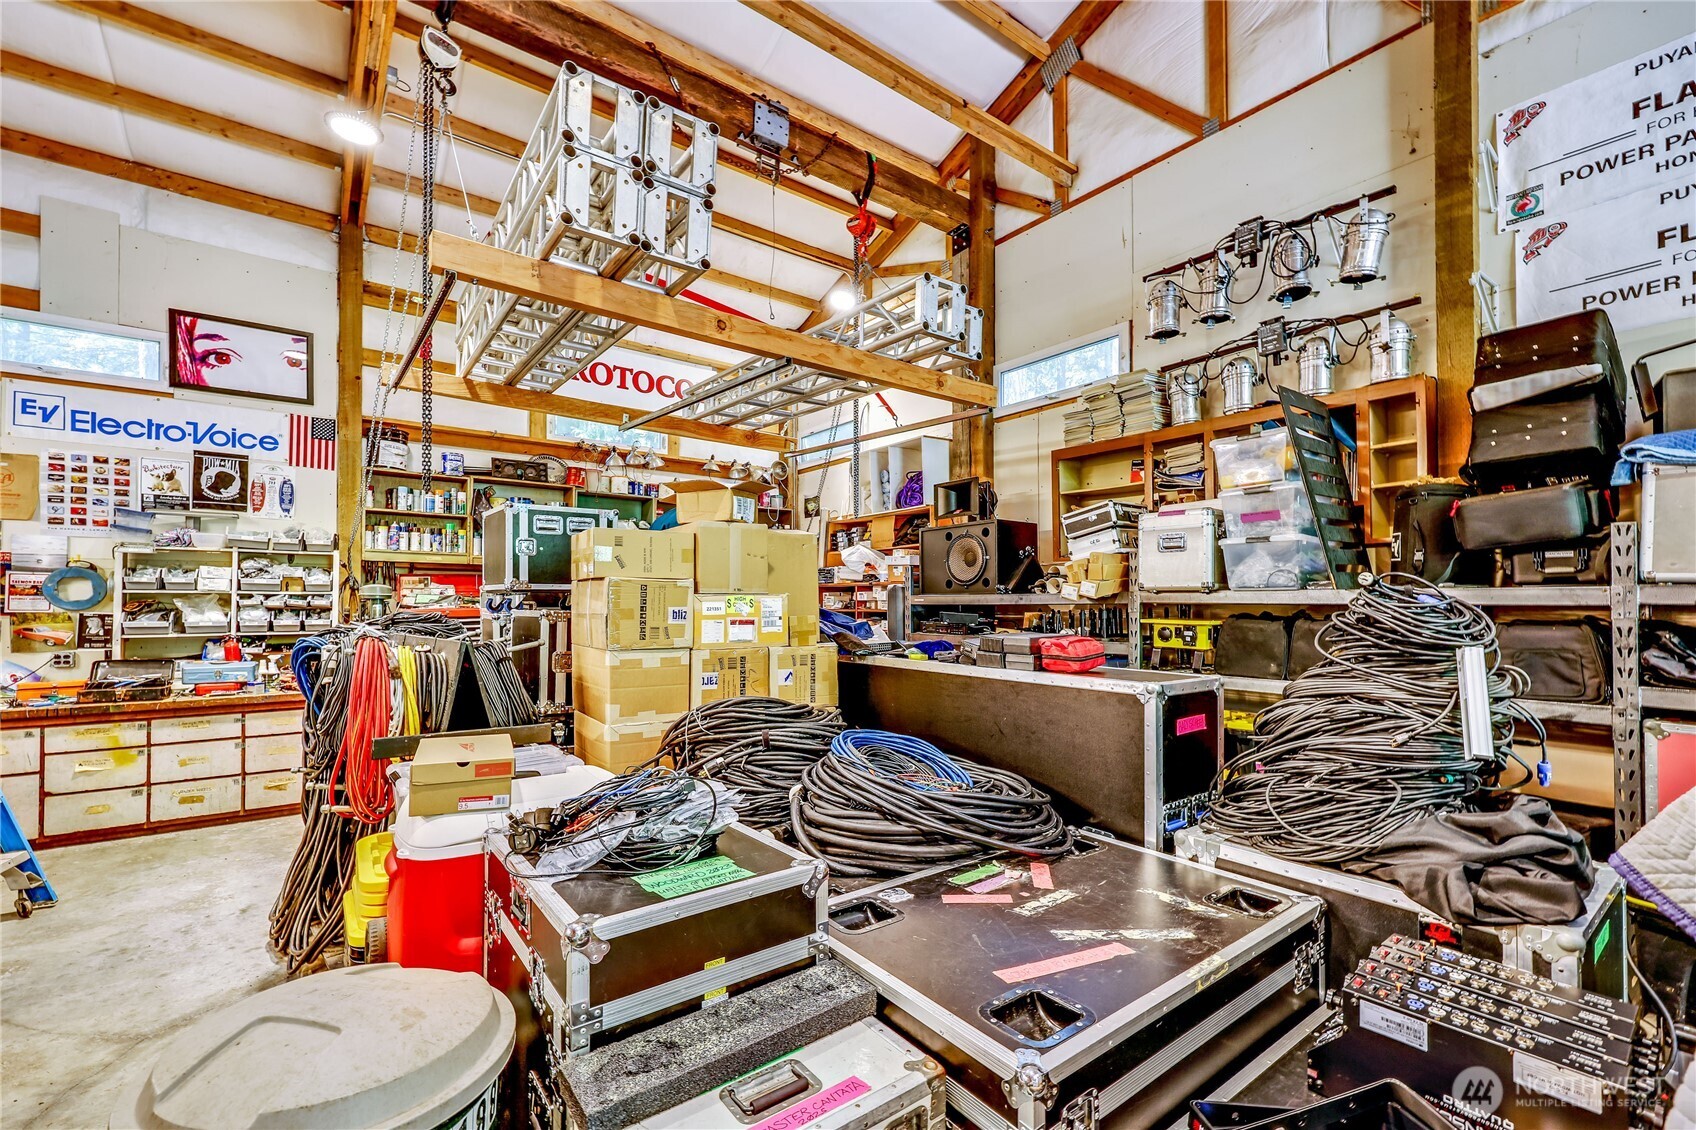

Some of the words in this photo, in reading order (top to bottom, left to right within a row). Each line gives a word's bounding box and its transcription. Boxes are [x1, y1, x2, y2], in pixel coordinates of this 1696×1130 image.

[1635, 42, 1696, 76] PUYA
[1647, 112, 1685, 133] FOR
[1560, 143, 1654, 186] POWER
[1582, 275, 1680, 311] POWER
[71, 409, 280, 451] Electro-Voice
[763, 1107, 811, 1130] ASTER
[812, 1081, 865, 1109] CANTATA
[1443, 1094, 1514, 1130] QUATTRO
